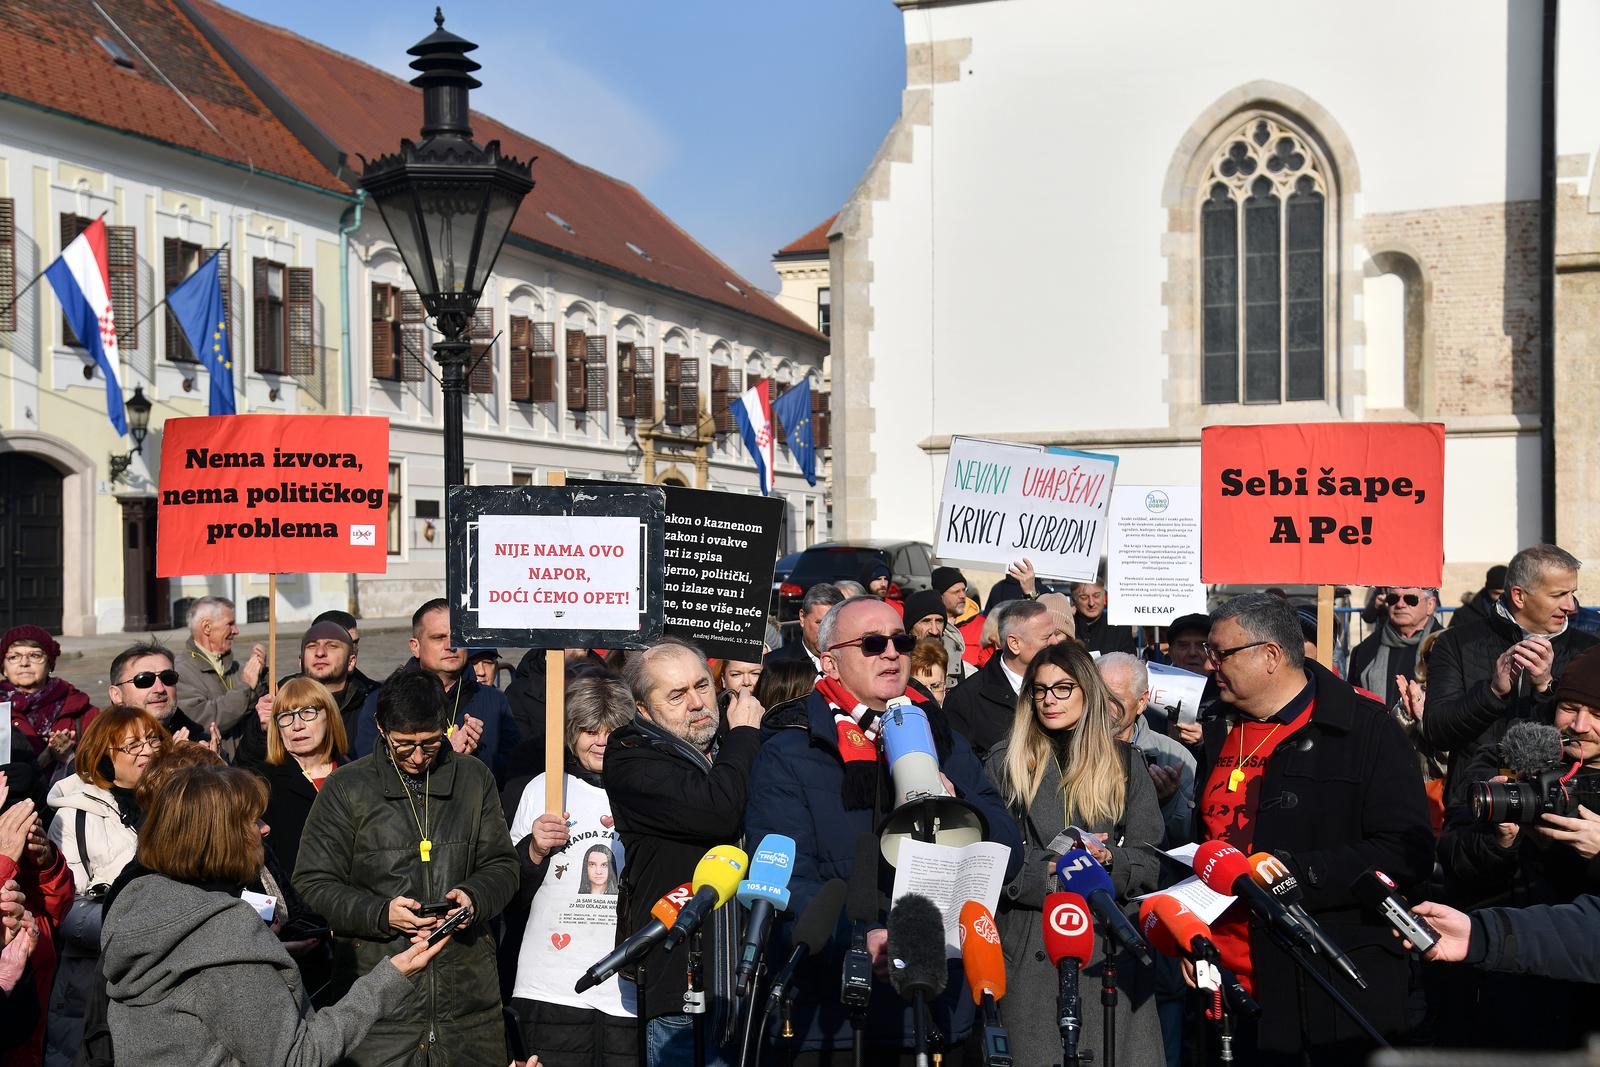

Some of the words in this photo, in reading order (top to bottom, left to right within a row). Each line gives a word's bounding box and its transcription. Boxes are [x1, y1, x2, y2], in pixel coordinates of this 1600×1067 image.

[185, 448, 265, 469] Nema
[273, 447, 363, 472] izvora,
[954, 458, 1012, 495] NEVINI
[1021, 464, 1105, 509] UHAPŠENI,
[1220, 467, 1308, 496] Sebi
[1317, 466, 1426, 504] šape,
[162, 486, 238, 505] nema
[246, 481, 384, 509] političkog
[206, 517, 339, 545] problema
[664, 513, 692, 526] akon
[703, 517, 763, 534] kaznenom
[946, 504, 1007, 546] KRIVCI
[1011, 512, 1097, 557] SLOBODNI
[1269, 516, 1301, 543] A
[1308, 516, 1373, 545] Pe!
[495, 543, 530, 558] NIJE
[534, 544, 584, 557] NAMA
[589, 545, 624, 557] OVO
[700, 533, 705, 544] i
[707, 535, 748, 549] ovakve
[664, 548, 680, 558] ari
[681, 548, 692, 559] iz
[693, 550, 723, 563] spisa
[528, 567, 591, 583] NAPOR,
[663, 565, 699, 579] jerno,
[701, 568, 753, 585] politički,
[488, 587, 529, 604] DOĆI
[533, 587, 579, 604] ĆEMO
[583, 591, 630, 605] OPET!
[664, 583, 680, 592] no
[681, 582, 715, 596] izlaze
[716, 588, 738, 599] van
[740, 588, 745, 599] i
[664, 600, 679, 610] ne,
[682, 599, 694, 609] to
[695, 602, 708, 611] se
[710, 602, 733, 614] više
[736, 607, 762, 618] neće
[1134, 606, 1175, 614] NELEXAP
[601, 830, 616, 840] ZA
[1202, 858, 1217, 883] VIDA
[768, 886, 782, 896] FM
